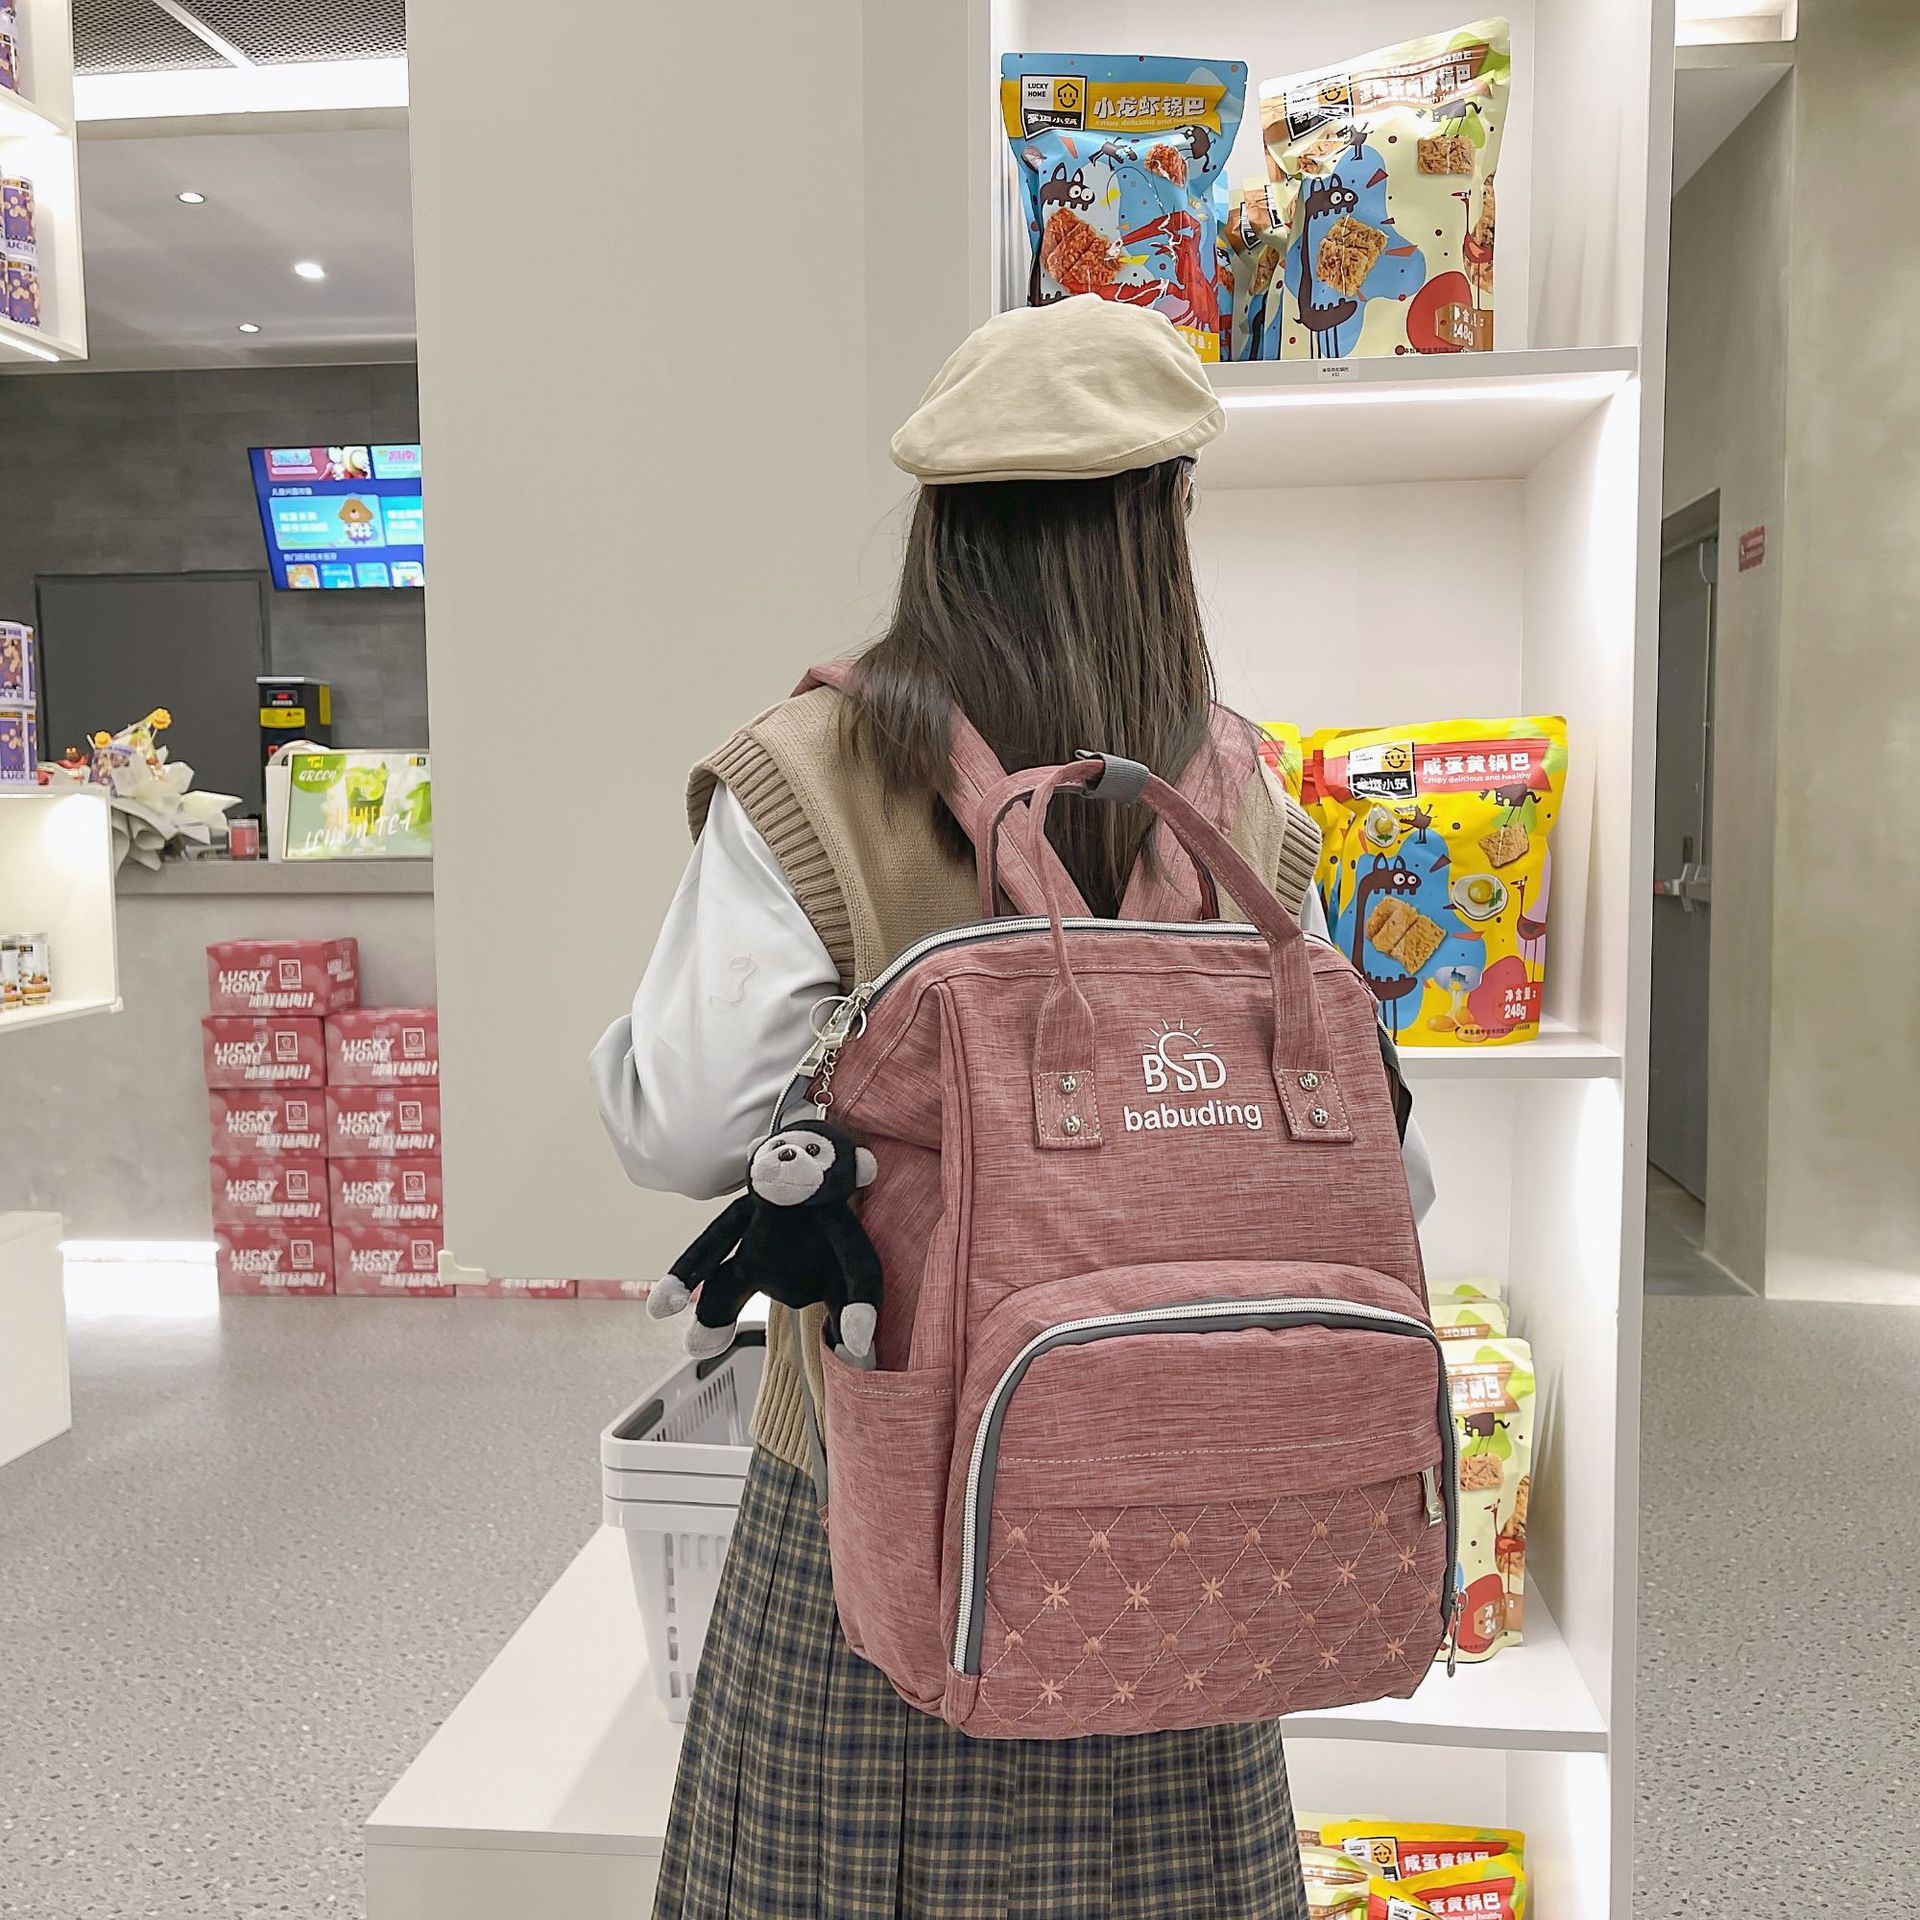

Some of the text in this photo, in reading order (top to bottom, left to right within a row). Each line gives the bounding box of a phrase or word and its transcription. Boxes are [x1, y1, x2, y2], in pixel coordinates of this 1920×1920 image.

[1093, 96, 1206, 119] 小龙虾锅巴
[1423, 752, 1530, 775] 咸蛋黄锅巴
[1448, 775, 1483, 783] delicious
[1501, 772, 1531, 780] healthy
[218, 970, 271, 983] LUCKY
[221, 982, 265, 994] HOME
[1504, 1003, 1526, 1020] 248g
[214, 1041, 267, 1054] LUCKY
[341, 1038, 395, 1052] LUCKY
[217, 1053, 263, 1066] HOME
[343, 1050, 388, 1063] HOME
[1142, 1032, 1227, 1093] BSD
[226, 1110, 278, 1123] LUCKY
[338, 1111, 391, 1124] LUCKY
[1123, 1100, 1263, 1131] babuding
[228, 1121, 272, 1134] HOME
[340, 1122, 385, 1136] HOME
[226, 1179, 278, 1192] LUCKY
[342, 1181, 394, 1194] LUCKY
[228, 1191, 272, 1203] HOME
[344, 1193, 390, 1205] HOME
[230, 1249, 283, 1262] LUCKY
[350, 1249, 404, 1262] LUCKY
[232, 1261, 278, 1273] HOME
[353, 1261, 399, 1274] HOME
[1443, 1327, 1477, 1337] HOME
[1300, 1832, 1320, 1840] LUC
[1428, 1892, 1501, 1914] 蛋黄锅巴
